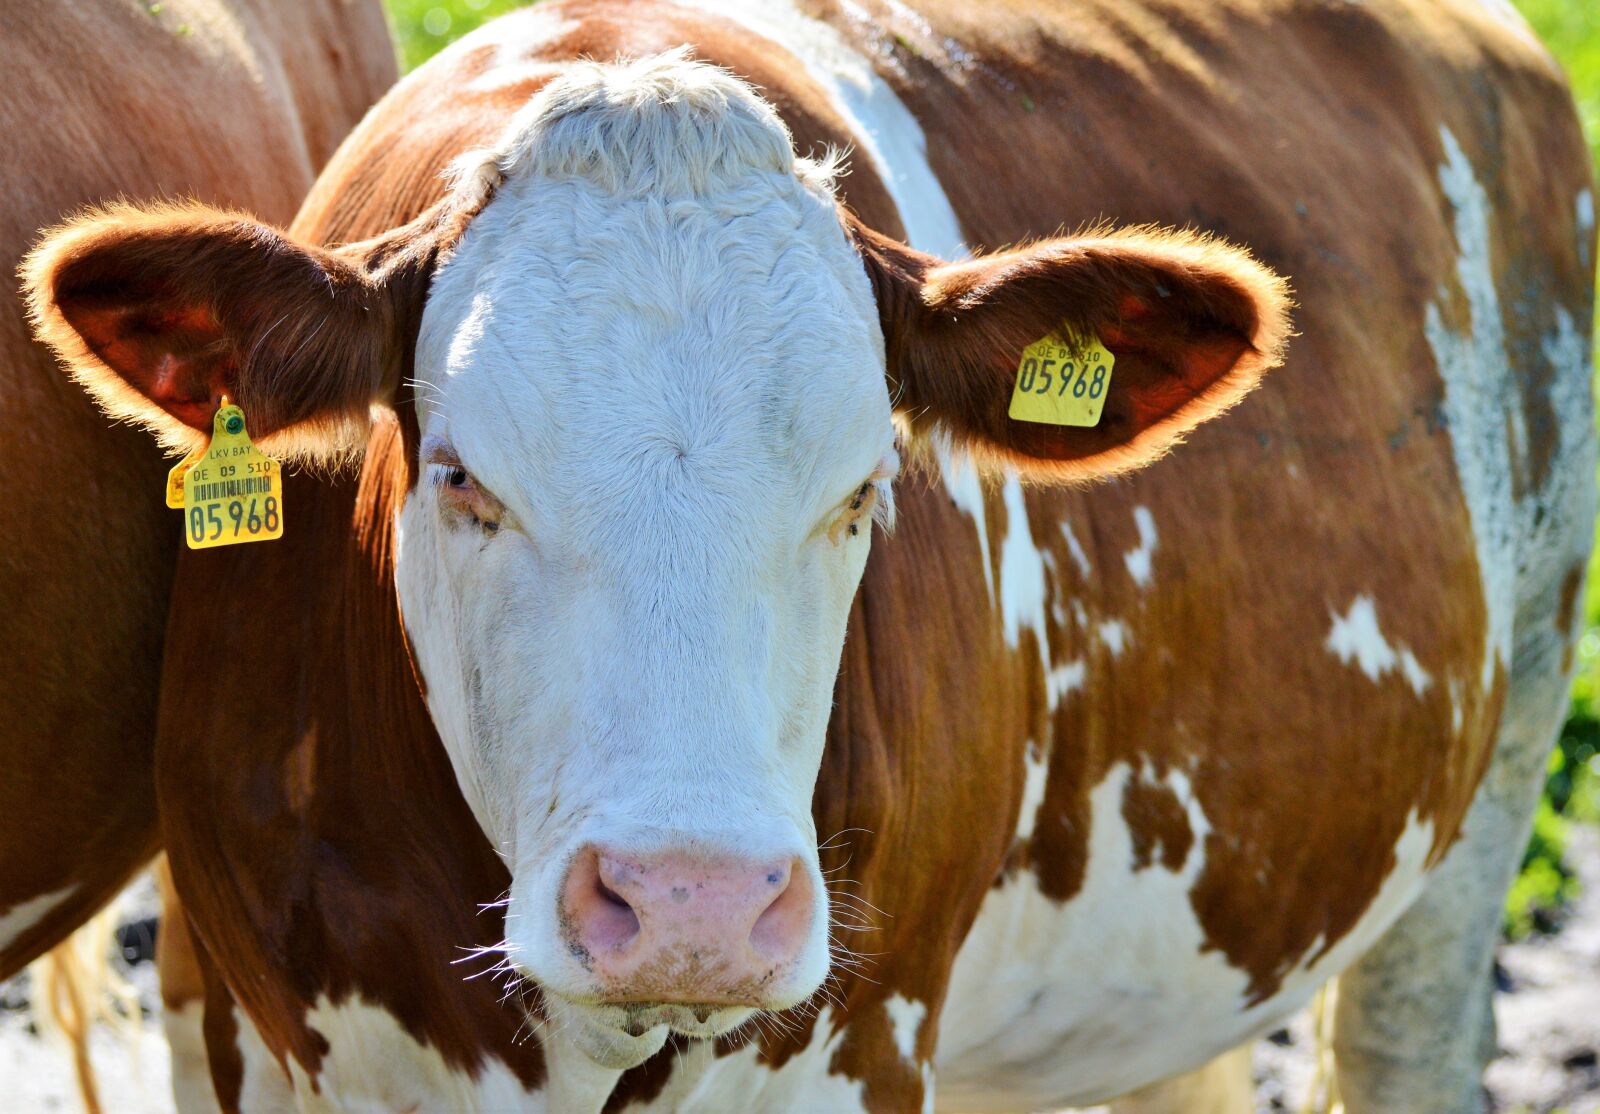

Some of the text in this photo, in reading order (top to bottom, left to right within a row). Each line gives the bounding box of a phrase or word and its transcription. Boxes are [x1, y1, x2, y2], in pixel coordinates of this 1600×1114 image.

[1037, 346, 1054, 358] DE
[1019, 357, 1106, 399] 05968
[210, 446, 251, 460] LKV BAY
[193, 461, 271, 481] DE 09 510
[190, 496, 279, 542] 05968
